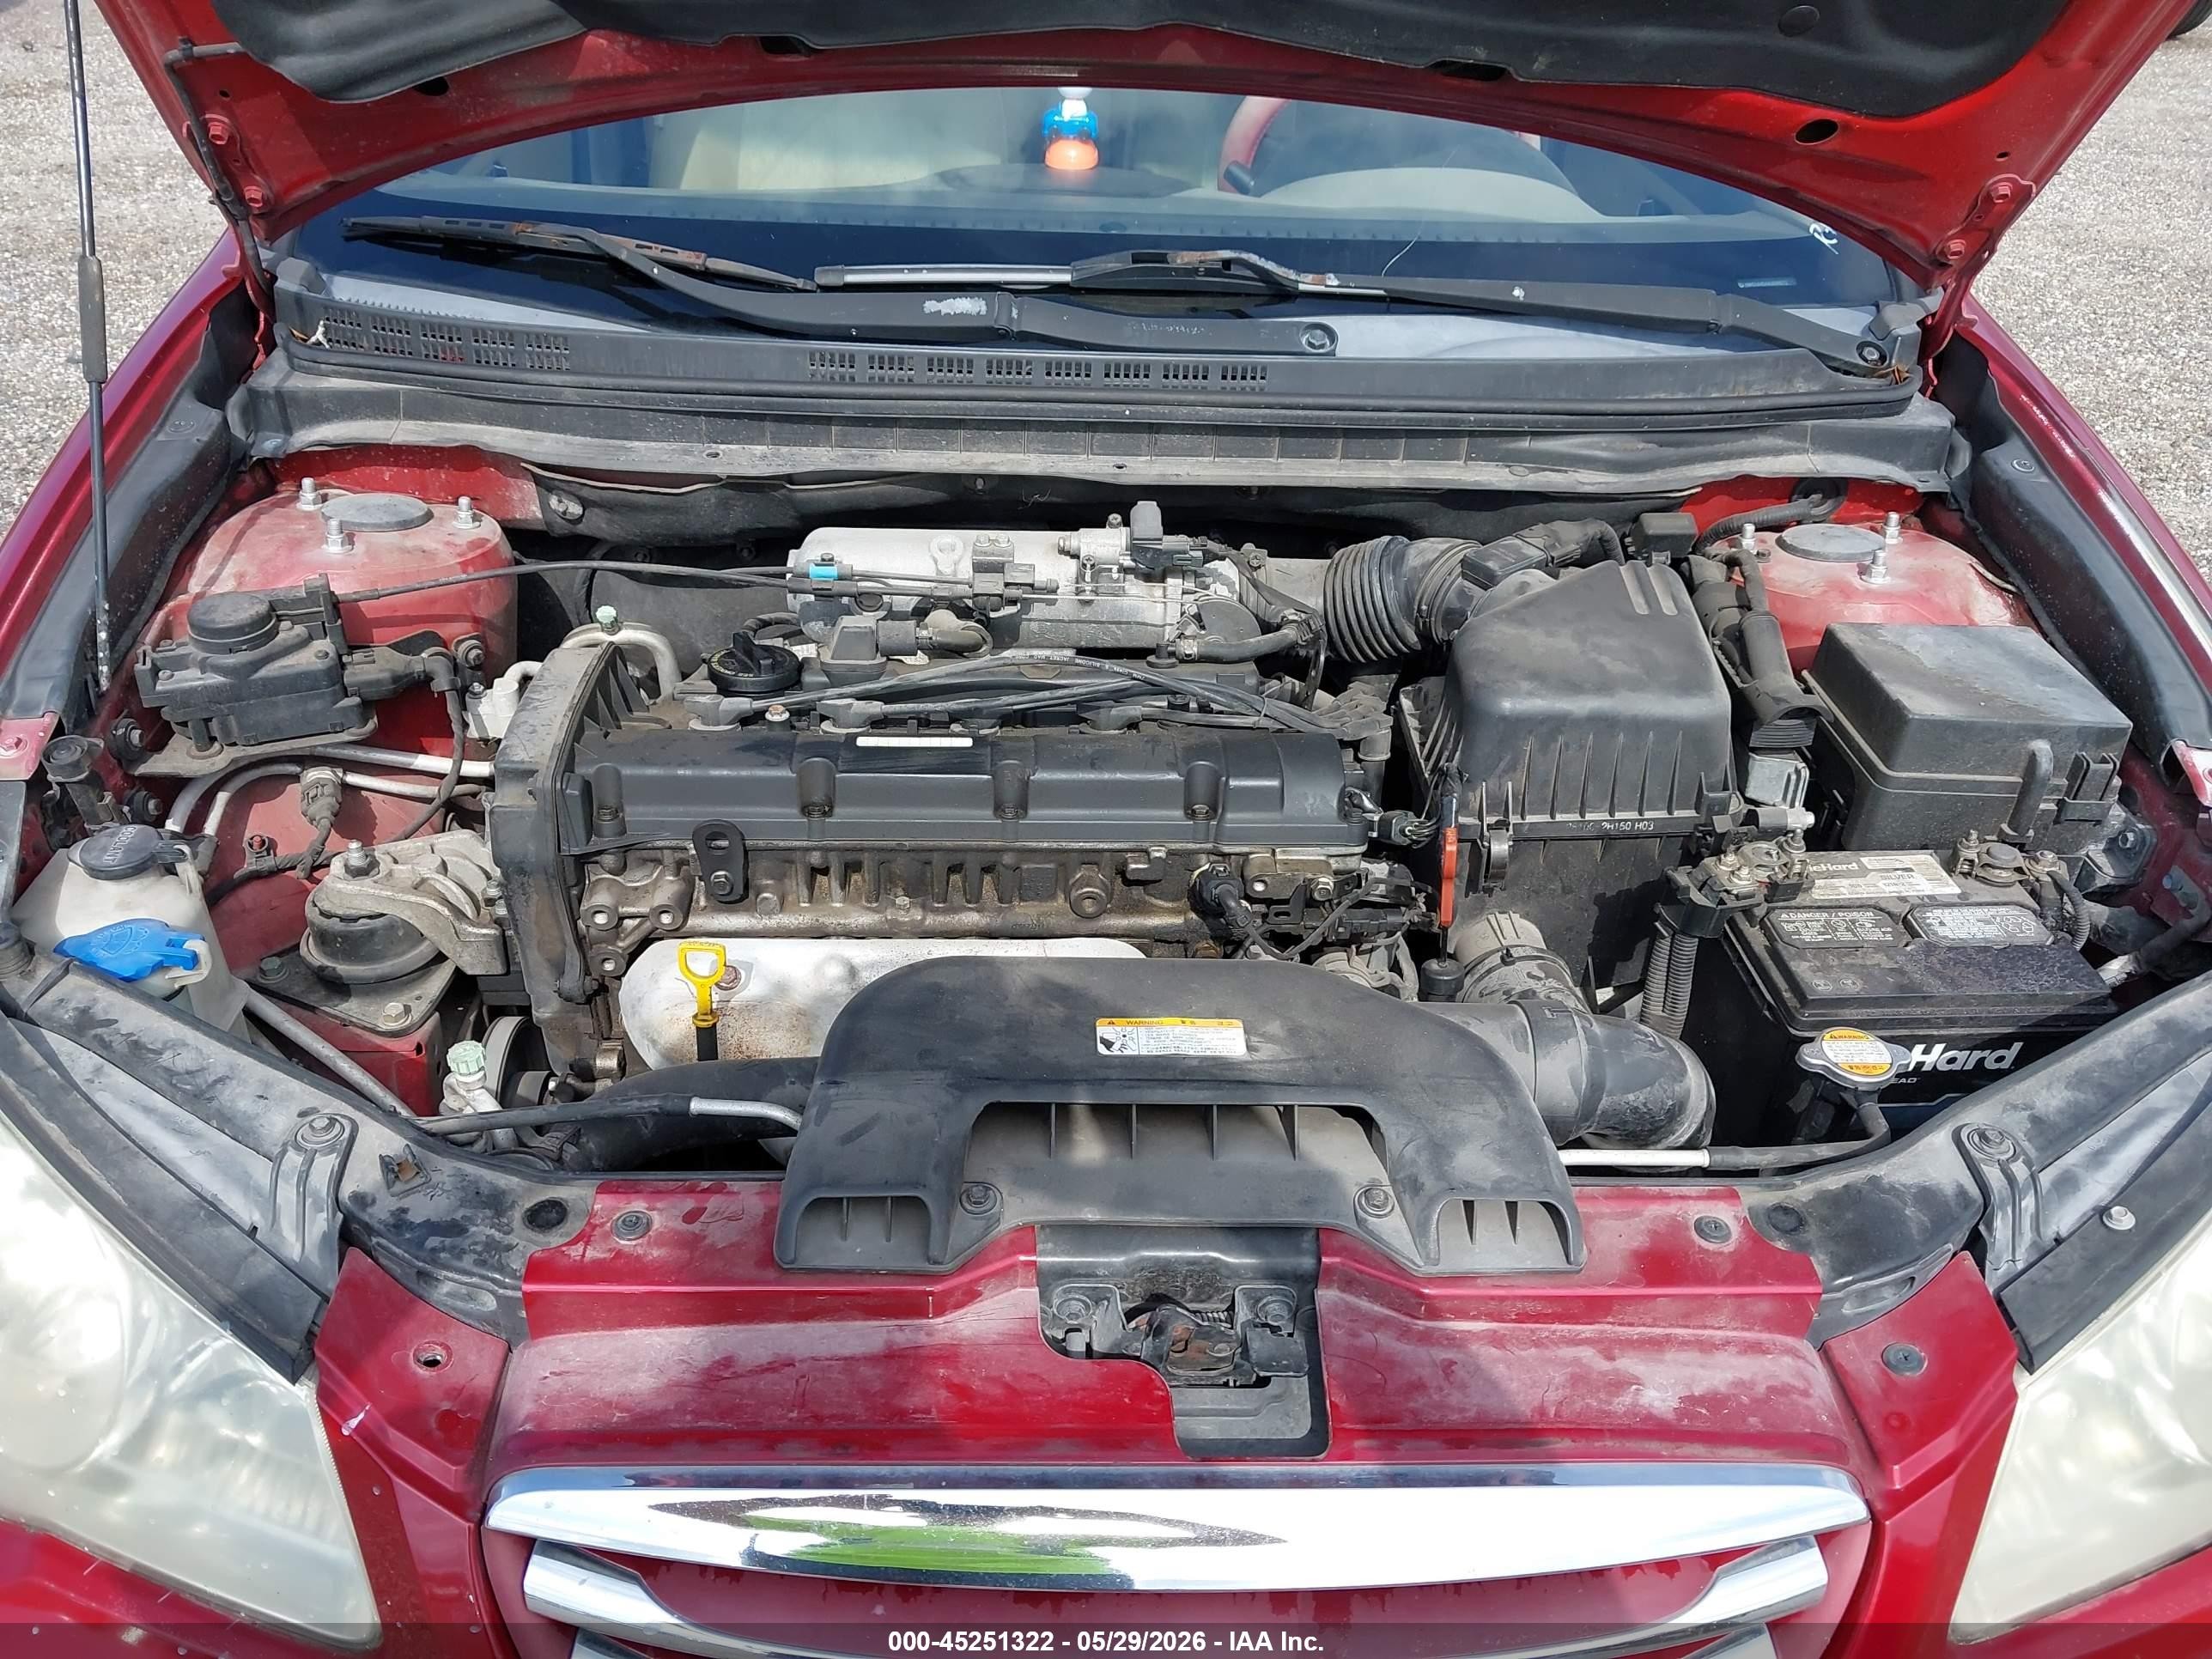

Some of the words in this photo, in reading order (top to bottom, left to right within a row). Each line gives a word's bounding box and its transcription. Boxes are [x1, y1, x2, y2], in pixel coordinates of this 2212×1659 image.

[1635, 821, 1654, 830] H03
[103, 825, 137, 864] COOLANT
[1808, 861, 1859, 872] ieHard
[1908, 1042, 2024, 1072] Hard
